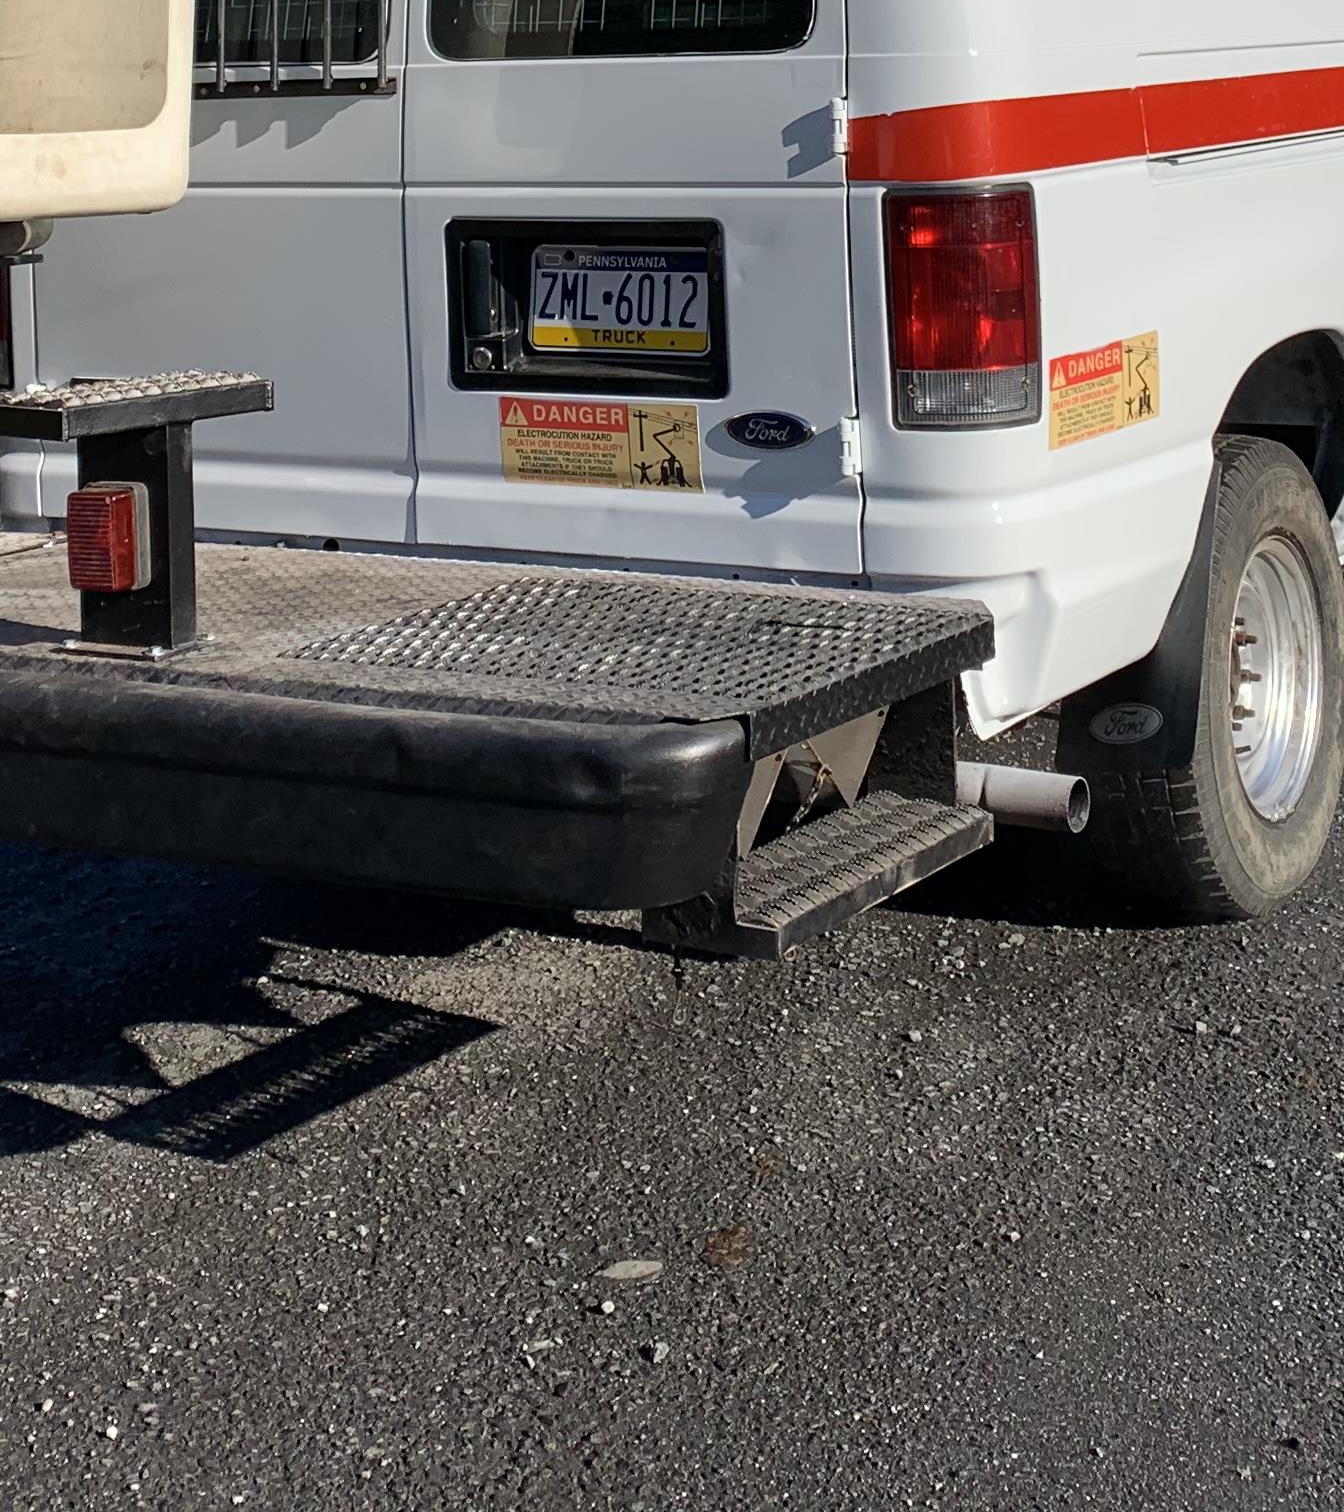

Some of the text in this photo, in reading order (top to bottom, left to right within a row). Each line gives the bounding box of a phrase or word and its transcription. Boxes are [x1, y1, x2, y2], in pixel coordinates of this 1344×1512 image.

[578, 255, 667, 268] PENNSYLVANIA
[592, 329, 646, 344] TRUCK
[1067, 348, 1121, 379] DANGER
[533, 404, 624, 426] DANGER
[517, 429, 612, 442] ELECTROCUTION HAZARD
[745, 418, 790, 441] Ford
[507, 438, 623, 453] DEATH OR SERIOUS INJURY
[1104, 710, 1148, 737] Ford
